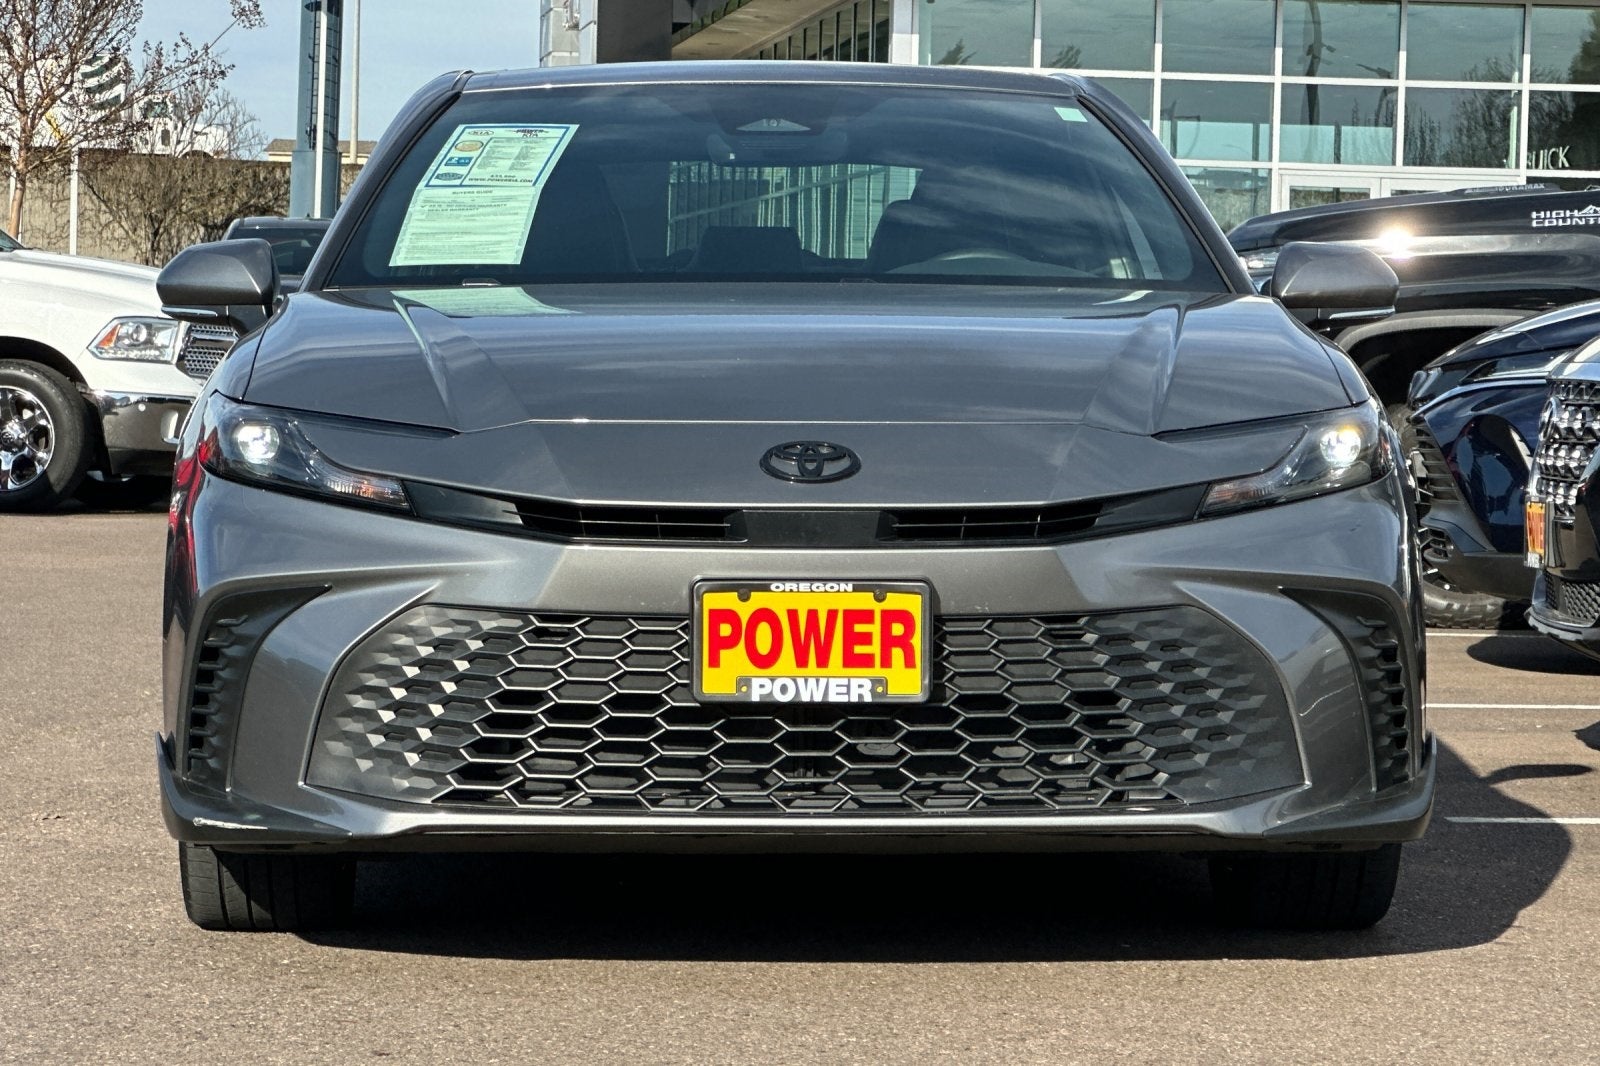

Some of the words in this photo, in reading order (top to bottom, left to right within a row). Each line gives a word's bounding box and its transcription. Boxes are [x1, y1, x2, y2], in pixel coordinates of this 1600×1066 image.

[1498, 182, 1545, 192] DURAMAX
[1531, 210, 1578, 219] HIGH
[1531, 217, 1600, 227] COUNT
[770, 583, 853, 593] OREGON
[707, 607, 916, 669] POWER
[751, 678, 872, 702] POWER
